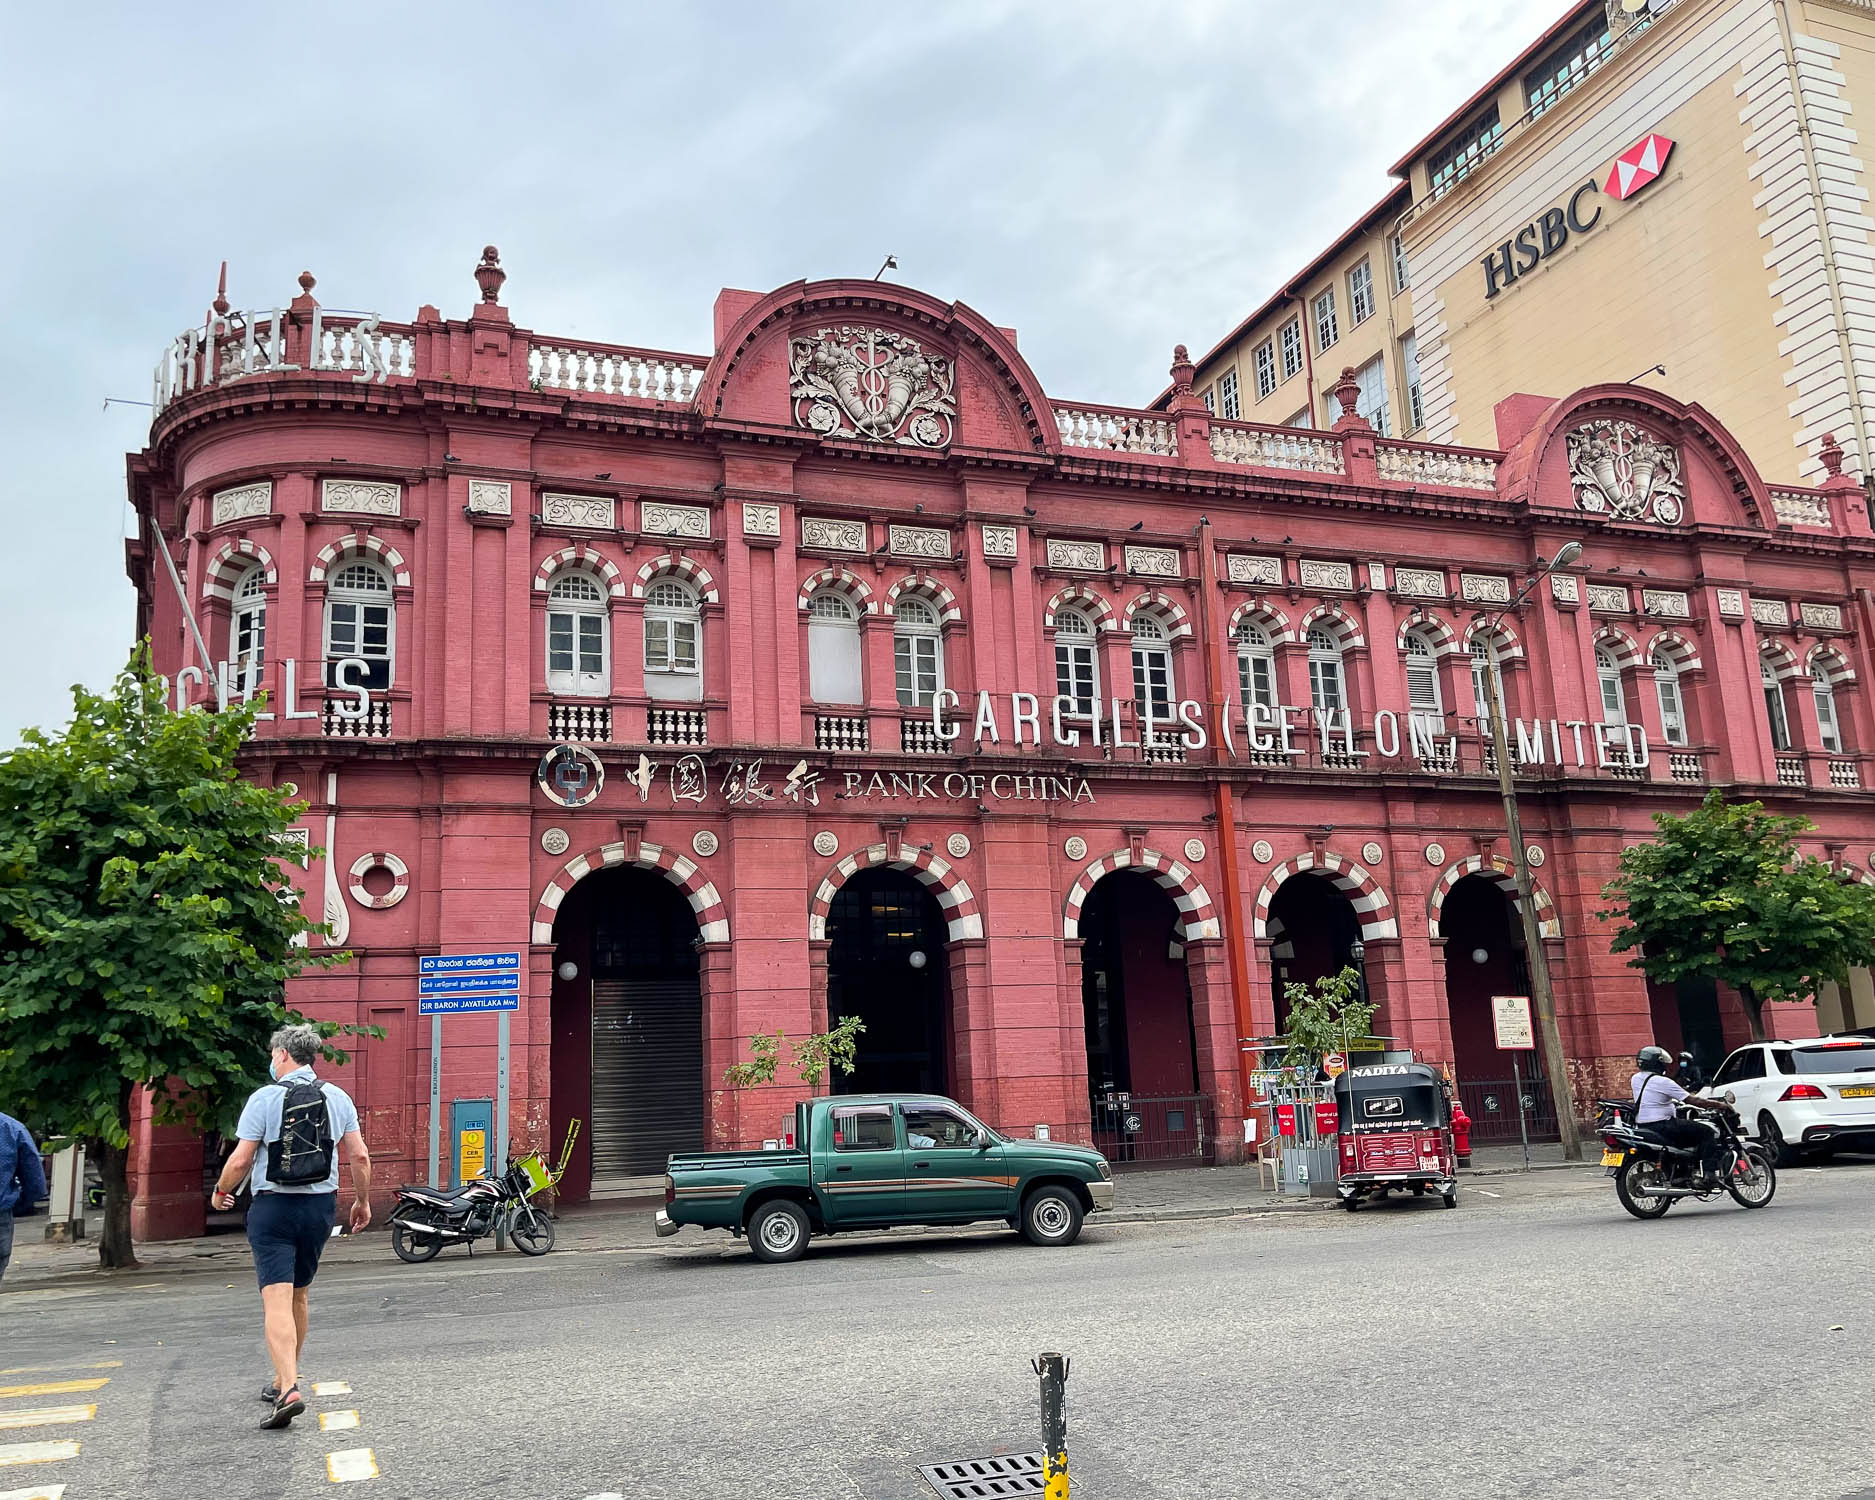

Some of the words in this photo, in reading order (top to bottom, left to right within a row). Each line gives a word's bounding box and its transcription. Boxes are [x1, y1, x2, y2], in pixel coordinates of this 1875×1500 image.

[1480, 178, 1602, 300] HSBC
[932, 688, 1208, 750] CARGILLS
[842, 771, 940, 799] BANK
[943, 773, 986, 800] OF
[990, 774, 1097, 804] CHINA
[421, 1002, 433, 1010] SIR
[434, 1001, 459, 1009] BARON
[460, 999, 502, 1008] JAYATILAKA
[1352, 1065, 1408, 1078] NADIYA
